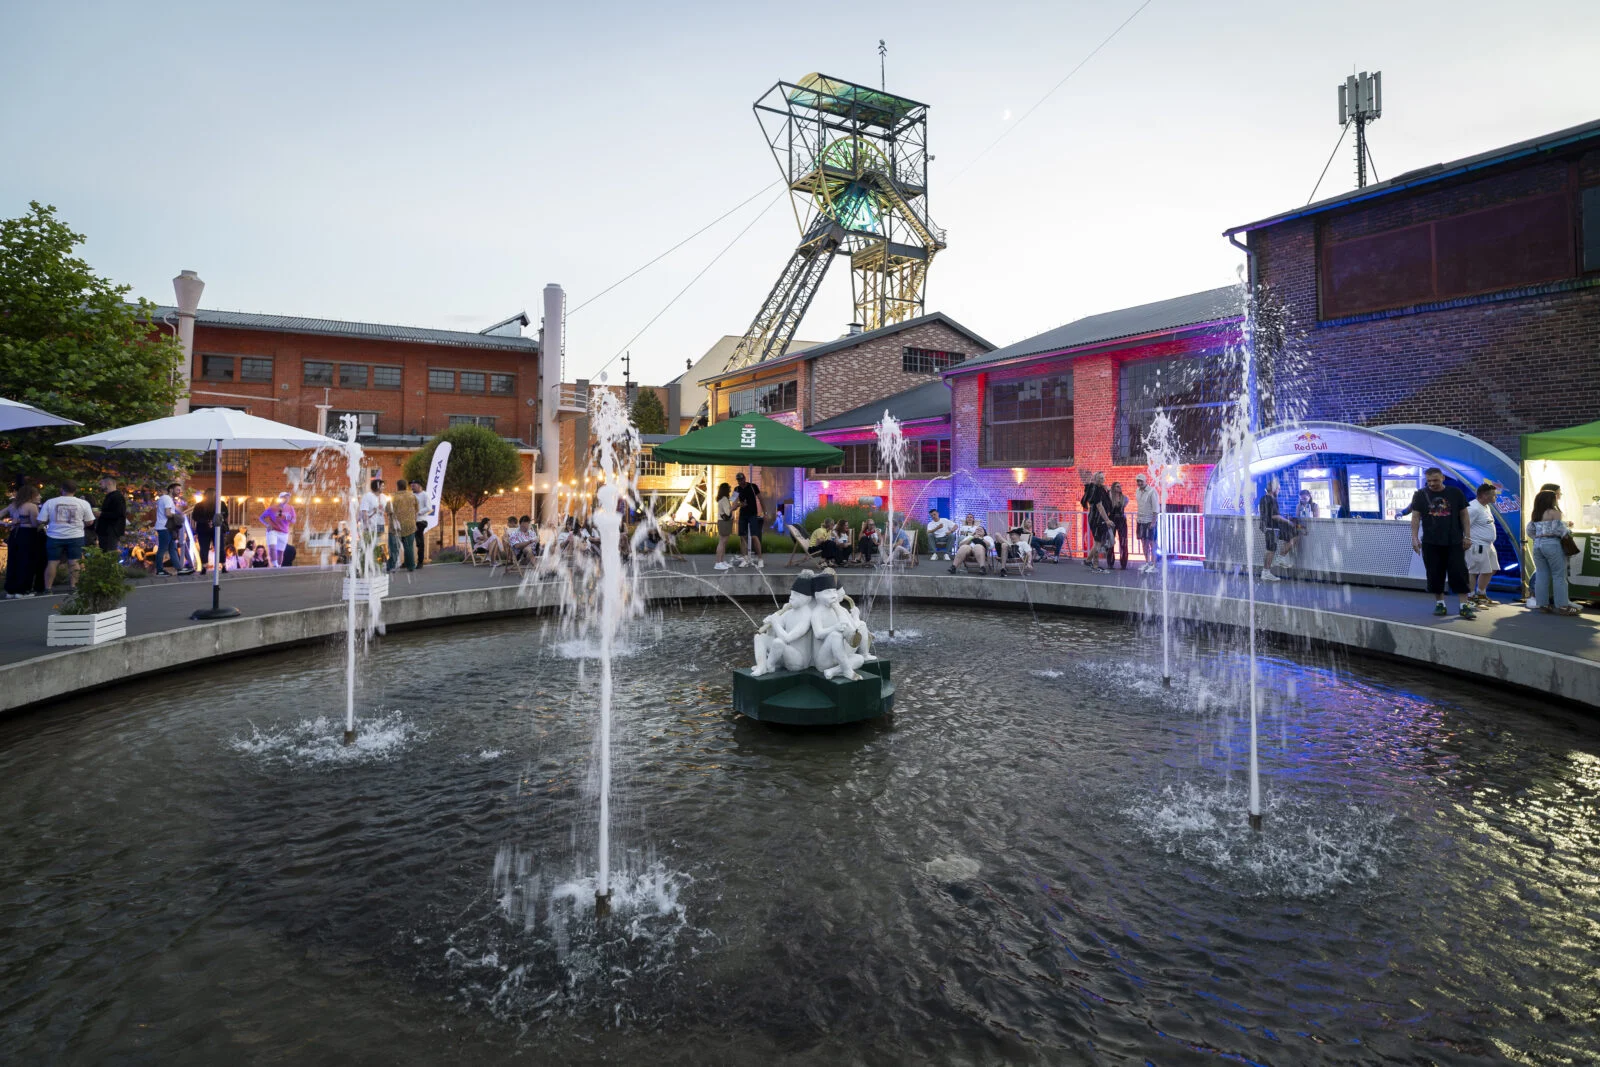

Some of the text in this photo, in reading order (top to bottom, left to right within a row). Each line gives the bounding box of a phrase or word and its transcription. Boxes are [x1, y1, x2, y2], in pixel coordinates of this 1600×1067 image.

[740, 427, 756, 448] LECH
[1294, 441, 1328, 451] Red Bull
[431, 459, 443, 500] VARTA
[1590, 535, 1600, 562] LECH
